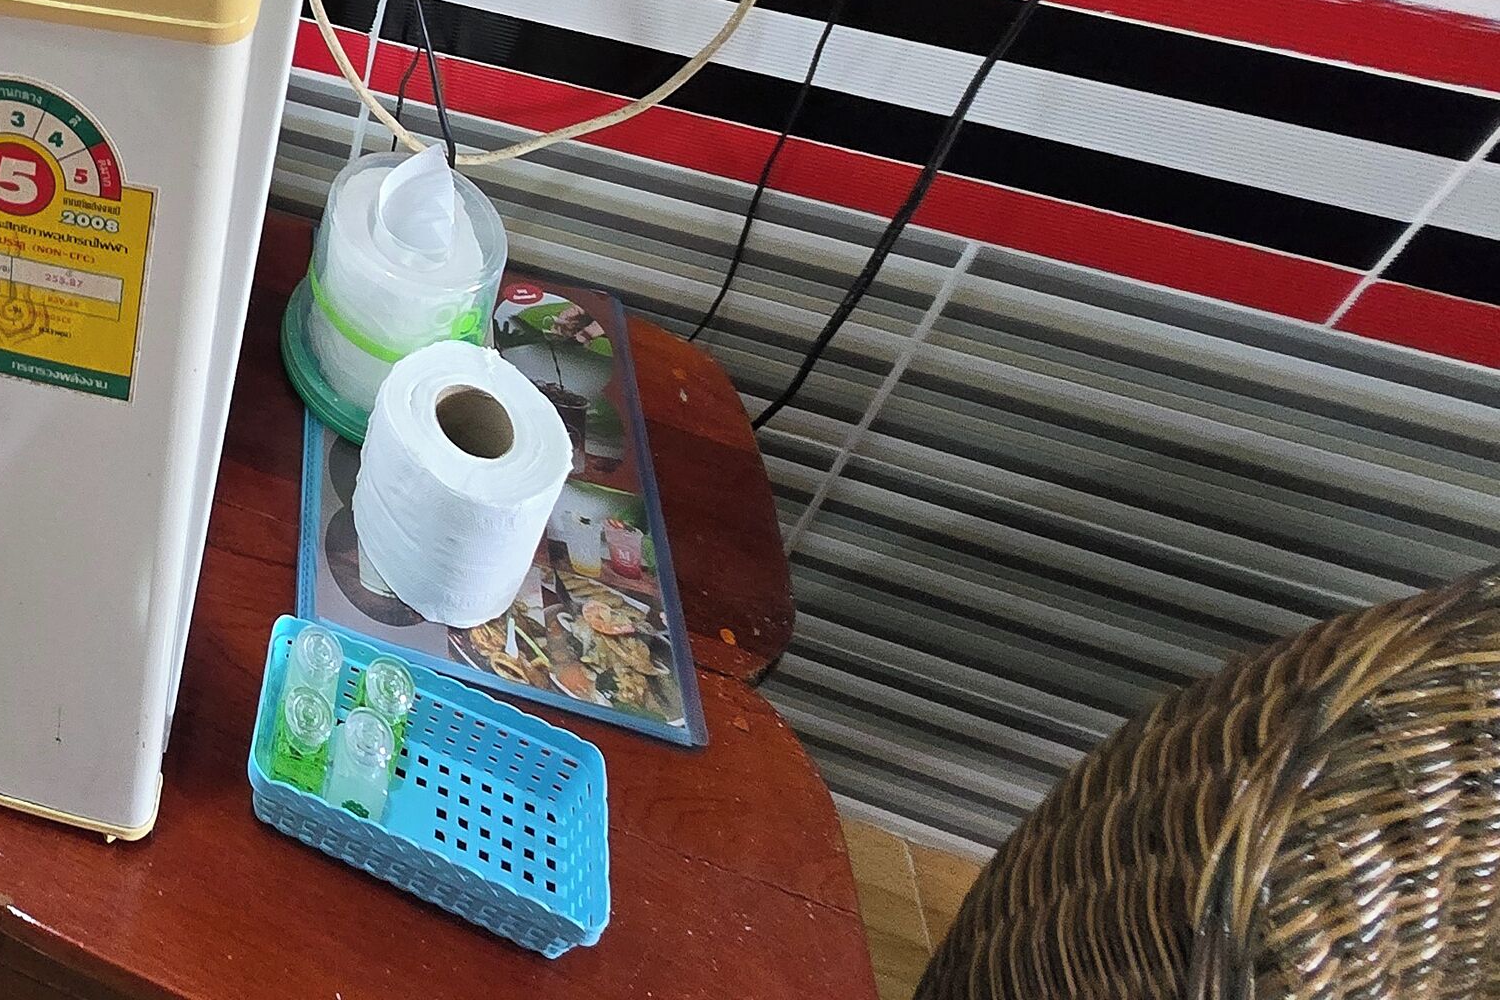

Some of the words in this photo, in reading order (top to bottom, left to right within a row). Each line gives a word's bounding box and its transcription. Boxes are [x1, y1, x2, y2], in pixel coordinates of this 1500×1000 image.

[10, 111, 25, 128] 3
[48, 131, 64, 148] 4
[74, 168, 88, 184] 5
[61, 210, 120, 233] 2008
